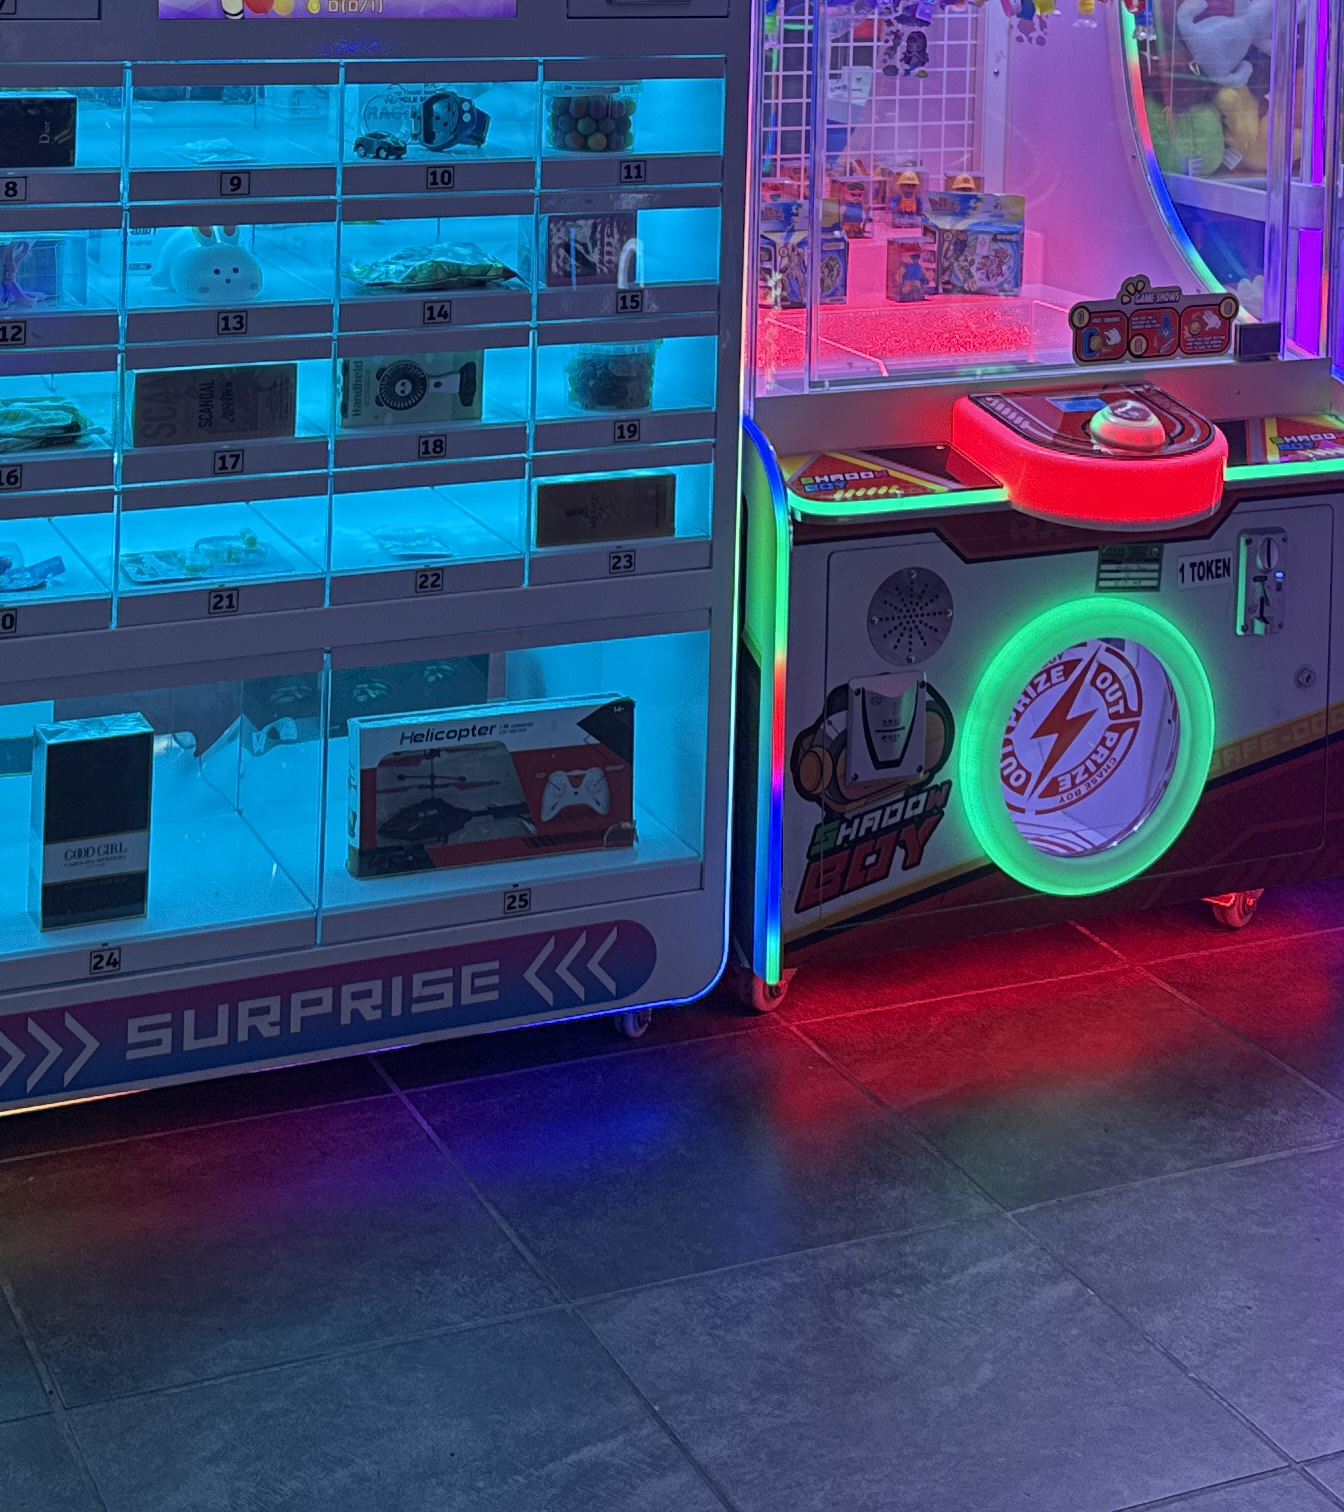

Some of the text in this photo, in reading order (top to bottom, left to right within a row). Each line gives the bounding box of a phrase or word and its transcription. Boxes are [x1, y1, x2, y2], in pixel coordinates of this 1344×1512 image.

[429, 169, 452, 186] 10
[622, 163, 645, 181] 11
[4, 181, 18, 198] 8
[229, 174, 242, 193] 9
[618, 293, 641, 312] 15
[1134, 292, 1155, 305] GAME
[221, 314, 245, 332] 13
[425, 304, 449, 323] 14
[351, 359, 364, 417] Handheld
[198, 378, 215, 429] SCANDAL
[616, 423, 638, 439] 19
[421, 438, 444, 455] 18
[218, 453, 241, 471] 17
[800, 470, 890, 485] SHADOW
[612, 554, 634, 570] 23
[1179, 563, 1185, 584] 1
[1189, 556, 1232, 583] TOKEN
[418, 572, 443, 590] 22
[212, 592, 237, 611] 21
[1008, 664, 1067, 728] PRIZE
[1095, 671, 1125, 715] OUT
[399, 723, 497, 746] Helicopter
[1057, 730, 1120, 793] PRIZE
[1058, 756, 1118, 804] CHASE BOY
[807, 780, 953, 861] SHADOW
[64, 840, 128, 861] GOOD GIRL
[795, 811, 945, 914] BOY
[506, 893, 529, 910] 25
[93, 950, 119, 971] 24
[125, 958, 501, 1062] SURPRISE
